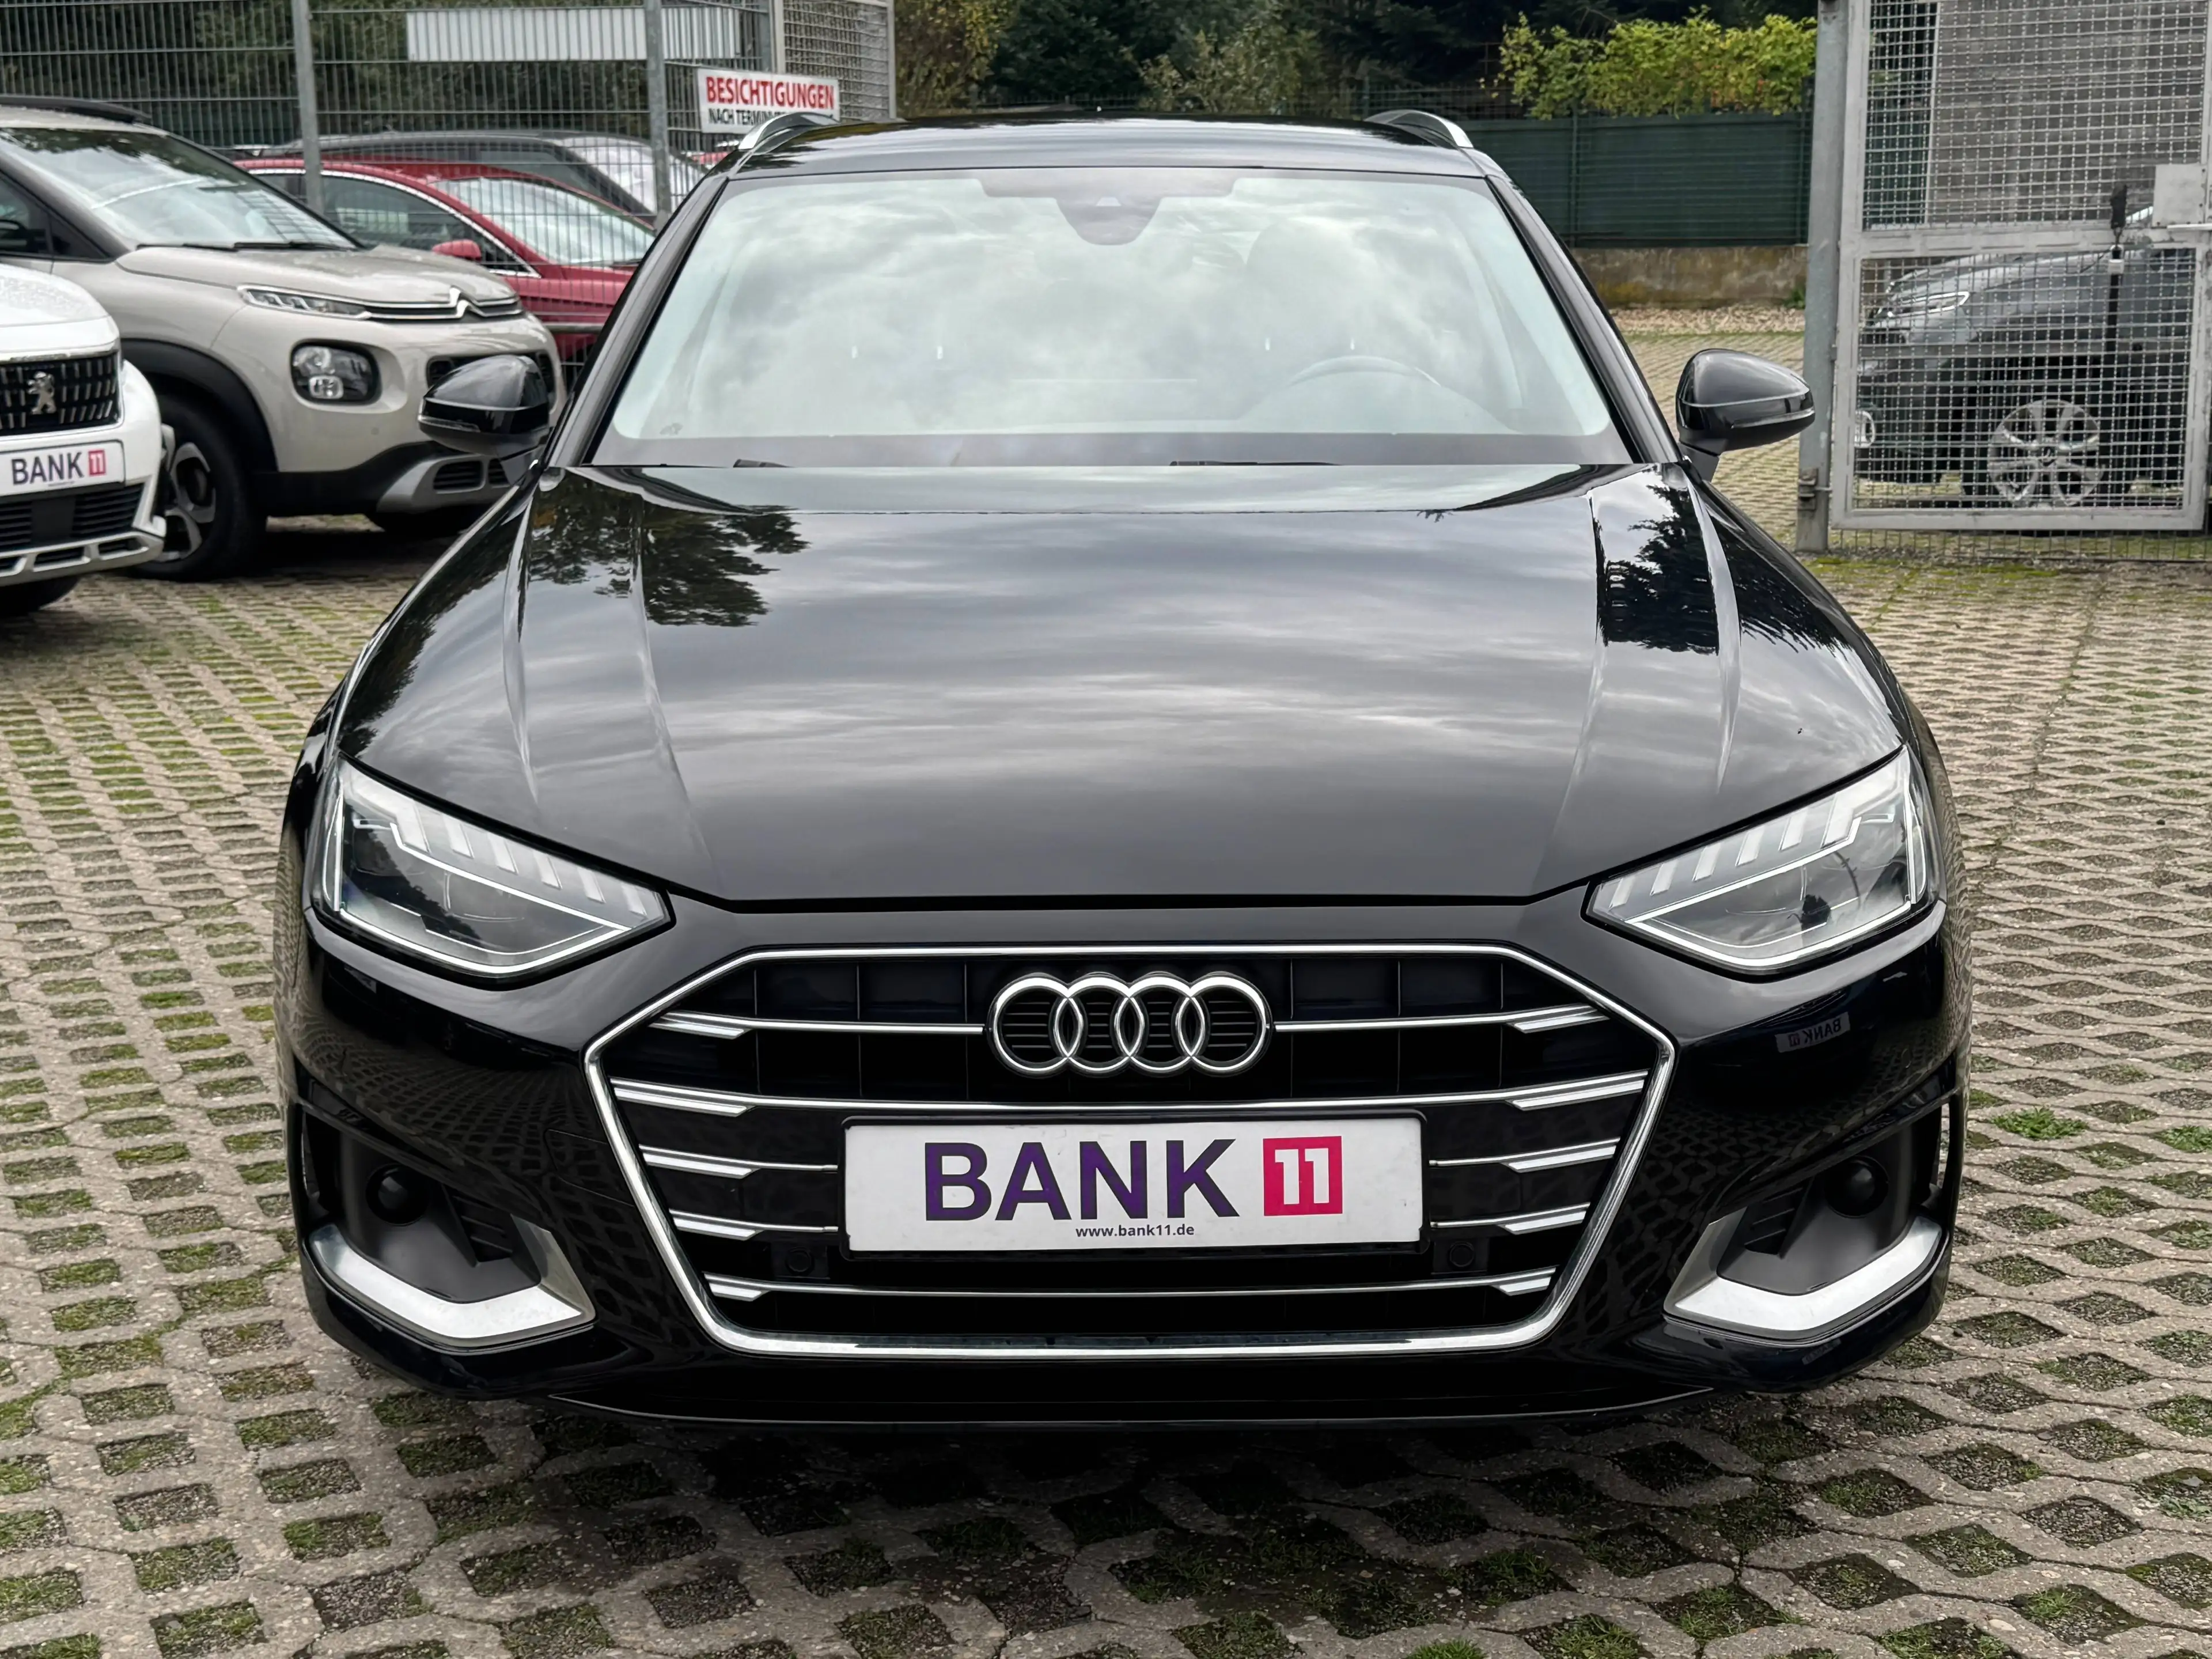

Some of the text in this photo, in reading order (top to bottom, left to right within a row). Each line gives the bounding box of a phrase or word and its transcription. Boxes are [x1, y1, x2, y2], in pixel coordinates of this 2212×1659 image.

[706, 76, 835, 109] BESICHTIGUNGEN
[708, 108, 734, 124] NACH
[11, 451, 105, 486] BANK 11
[924, 1138, 1333, 1221] BANK 11
[1075, 1223, 1195, 1237] www.bank11.de
